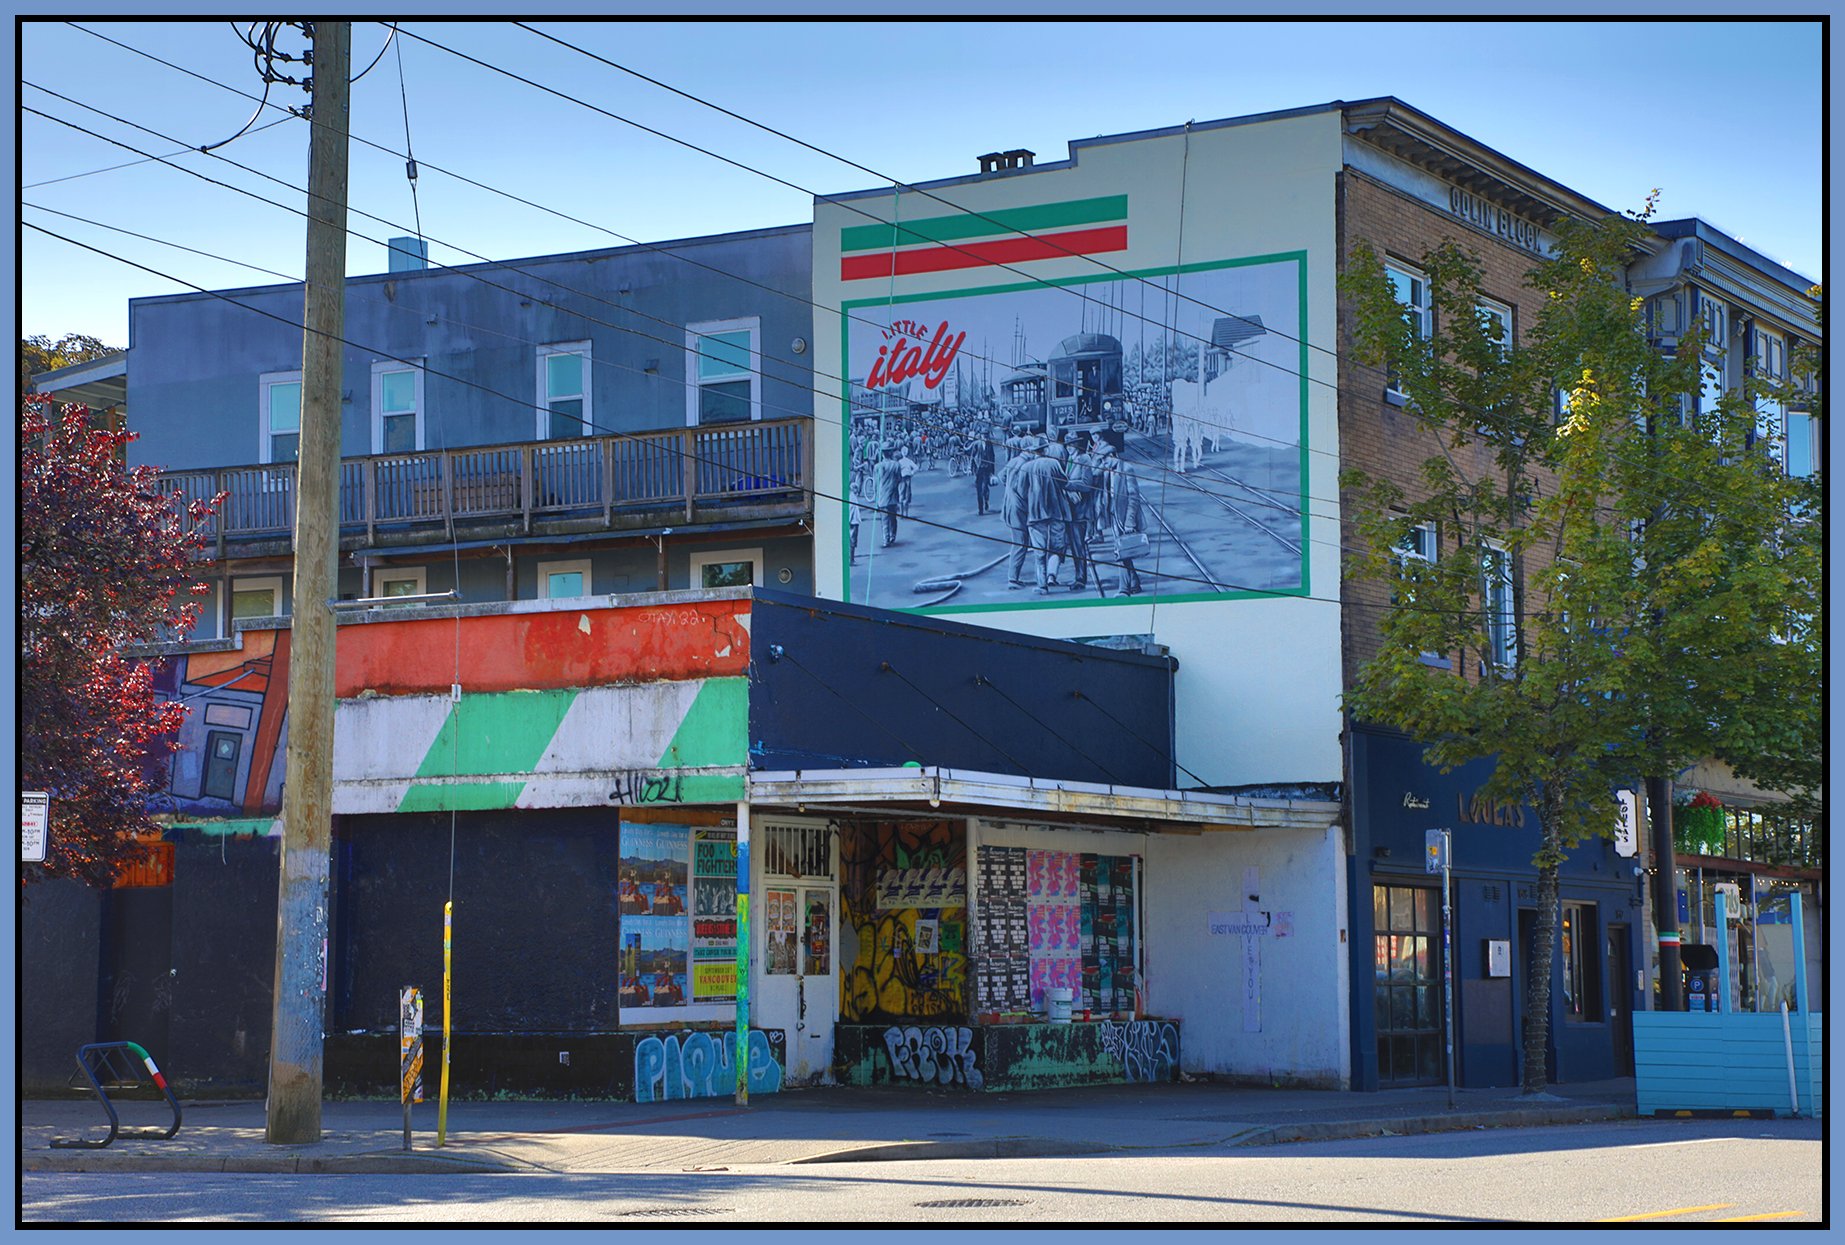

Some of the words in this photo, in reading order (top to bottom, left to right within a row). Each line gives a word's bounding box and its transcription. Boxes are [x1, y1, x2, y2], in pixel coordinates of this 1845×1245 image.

[1496, 207, 1542, 253] BLOCK
[881, 319, 929, 341] LITTLE
[865, 320, 967, 391] italy
[655, 839, 688, 849] GUINNESS
[697, 843, 715, 859] FOO
[696, 859, 738, 874] FIGHTER
